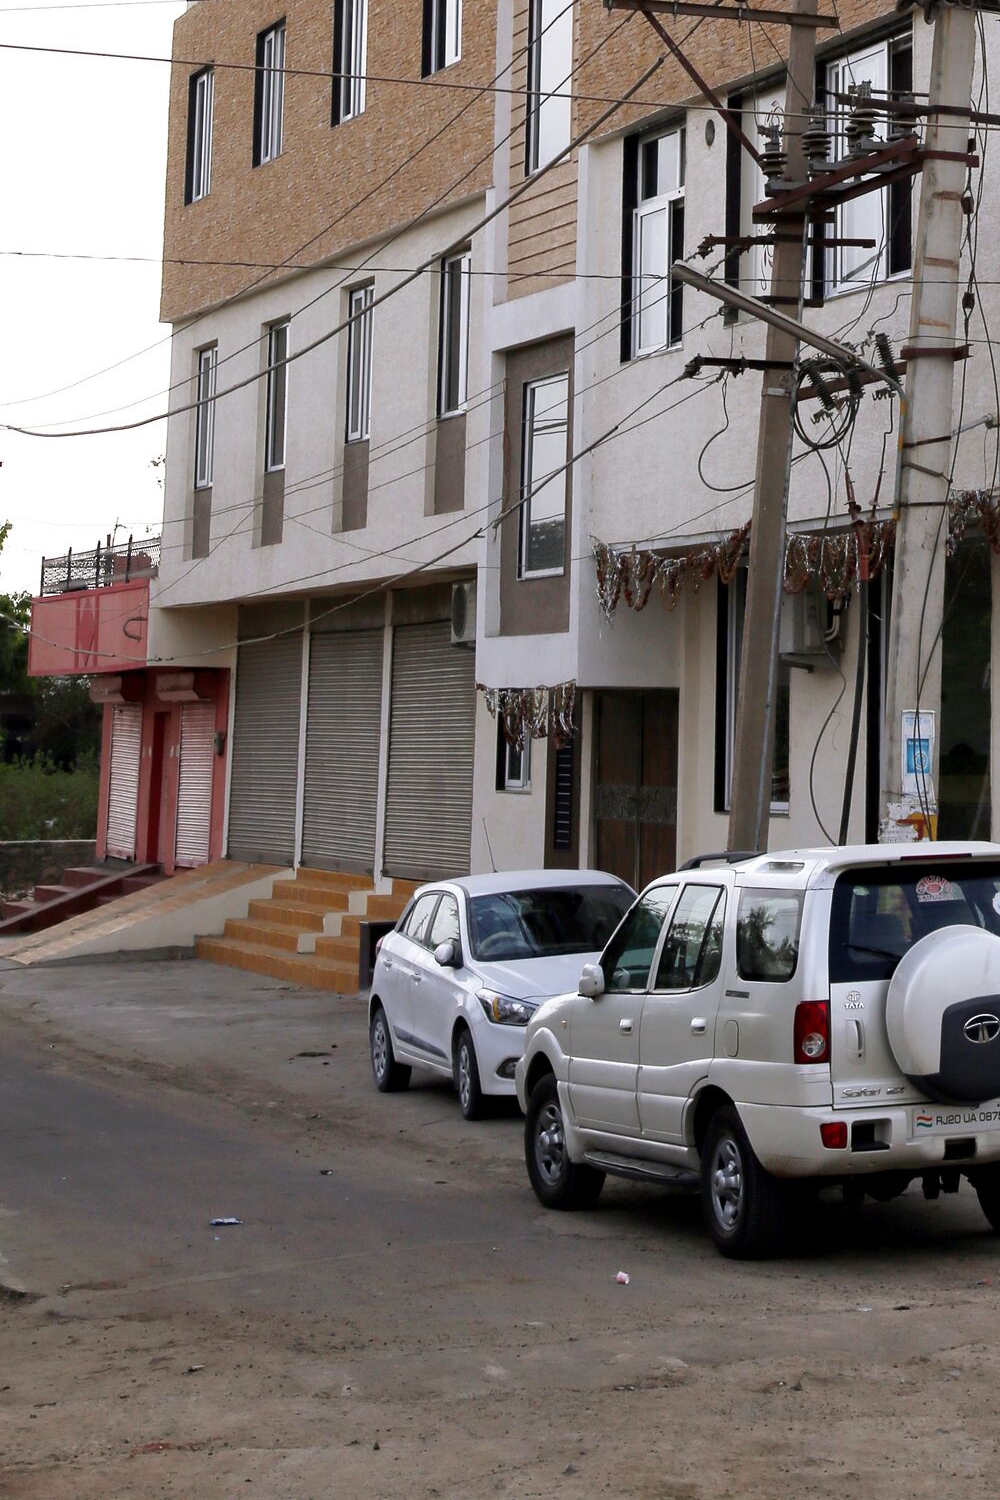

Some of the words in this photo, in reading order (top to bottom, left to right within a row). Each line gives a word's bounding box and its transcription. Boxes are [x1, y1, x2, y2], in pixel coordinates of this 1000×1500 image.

[841, 1087, 881, 1099] Safari
[935, 1114, 962, 1126] RJ20
[963, 1113, 977, 1123] UA
